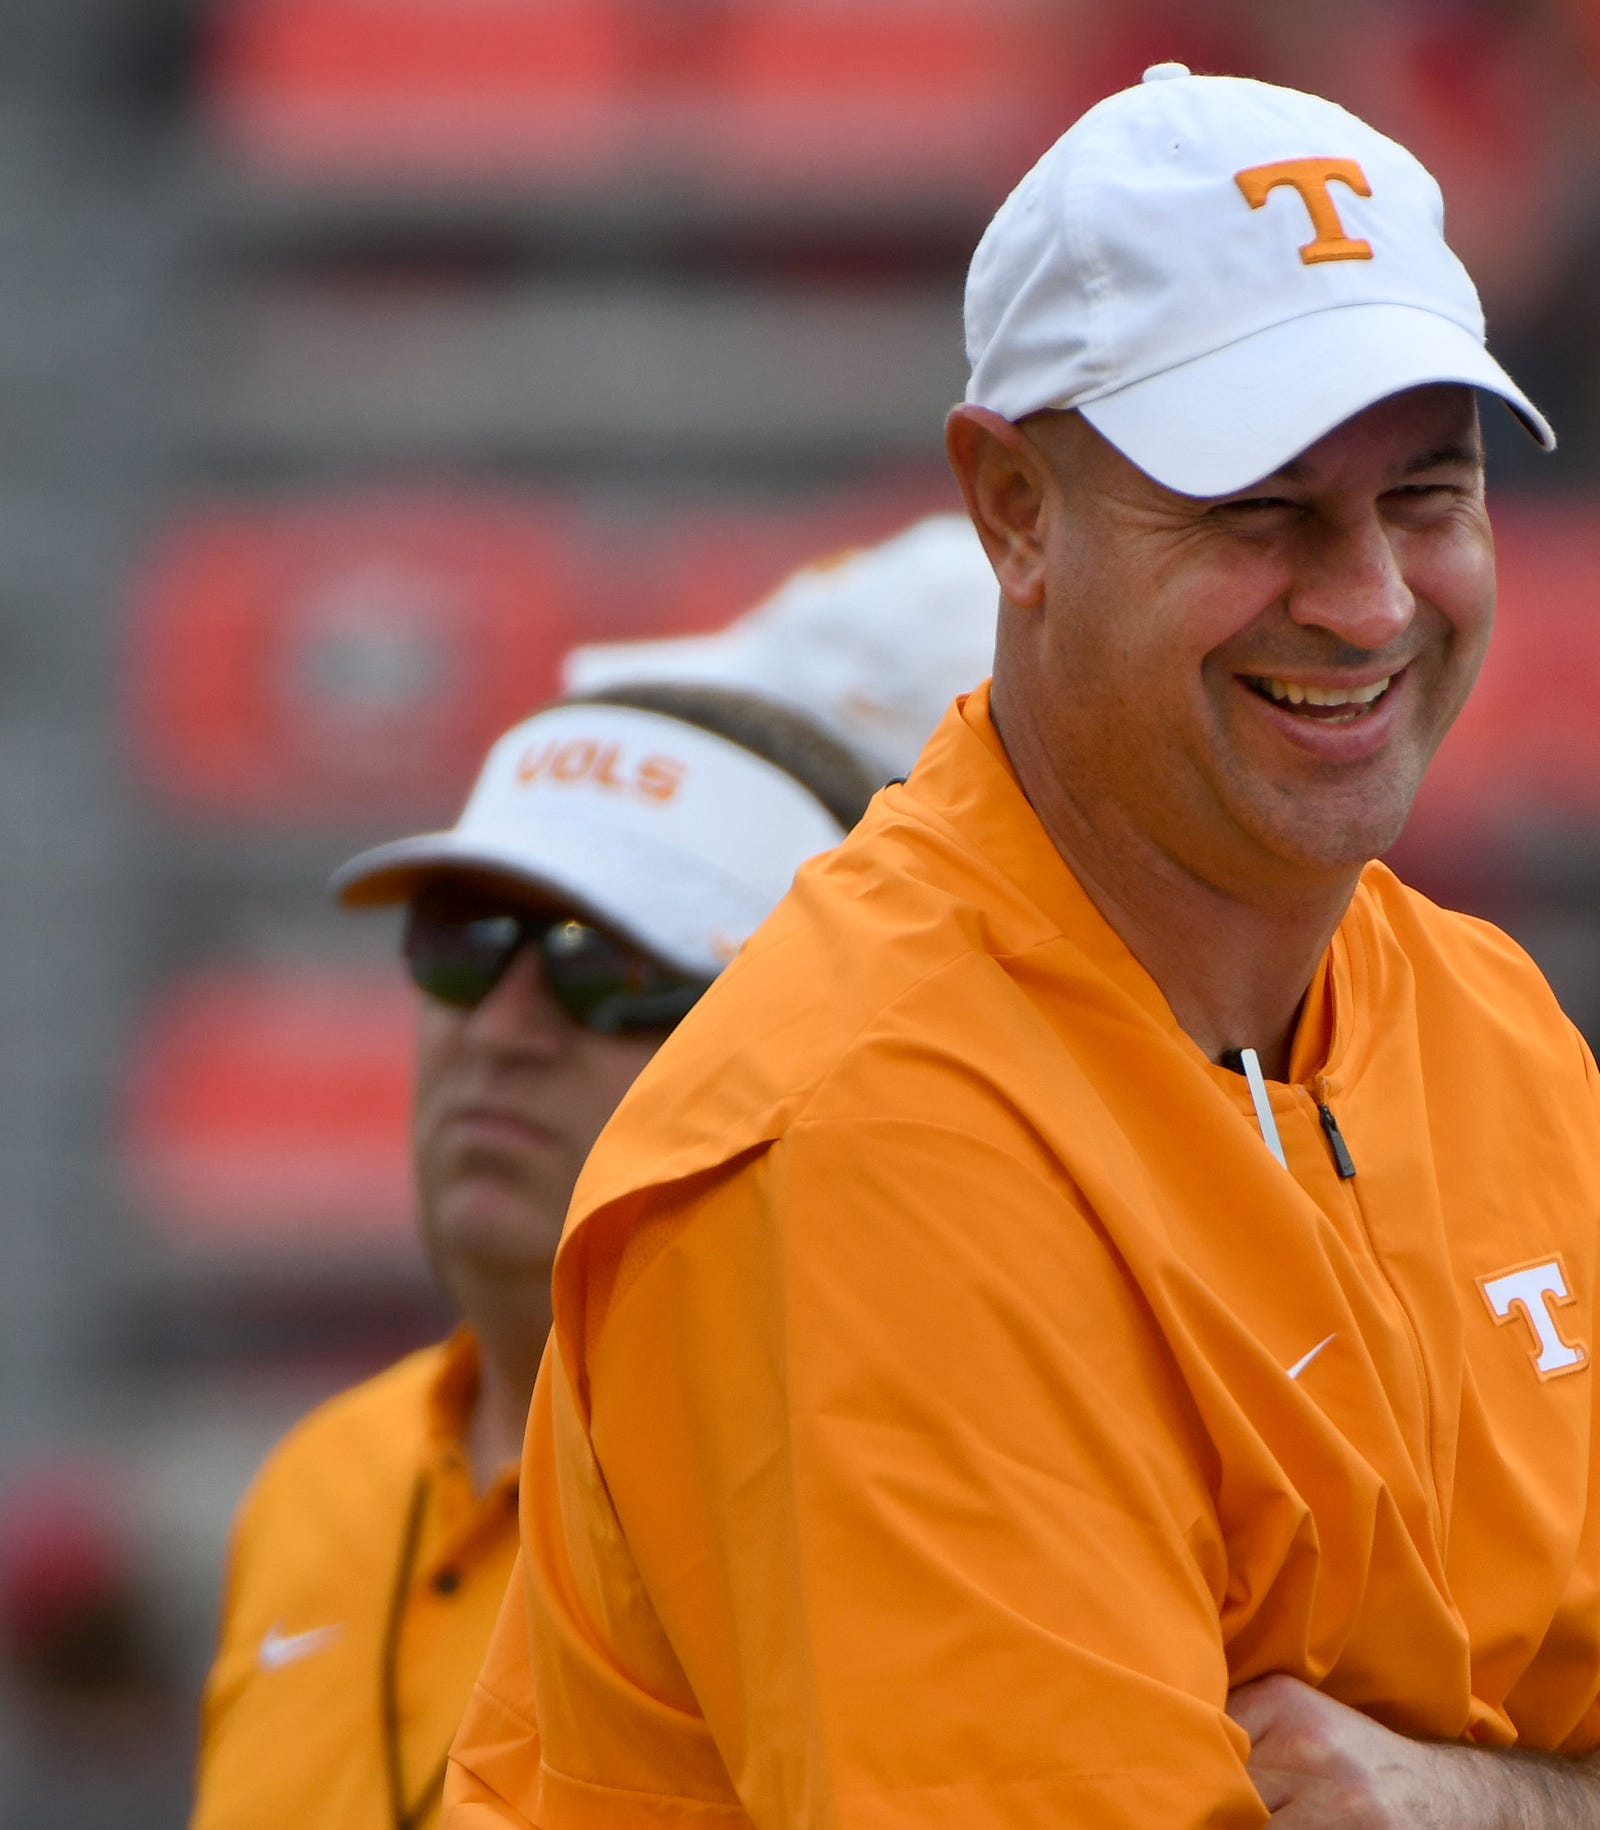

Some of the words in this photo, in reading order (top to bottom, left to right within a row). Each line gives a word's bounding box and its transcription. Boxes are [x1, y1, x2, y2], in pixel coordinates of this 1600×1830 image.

[1234, 156, 1373, 265] T
[516, 738, 687, 802] VOLS
[1479, 1256, 1587, 1378] T
